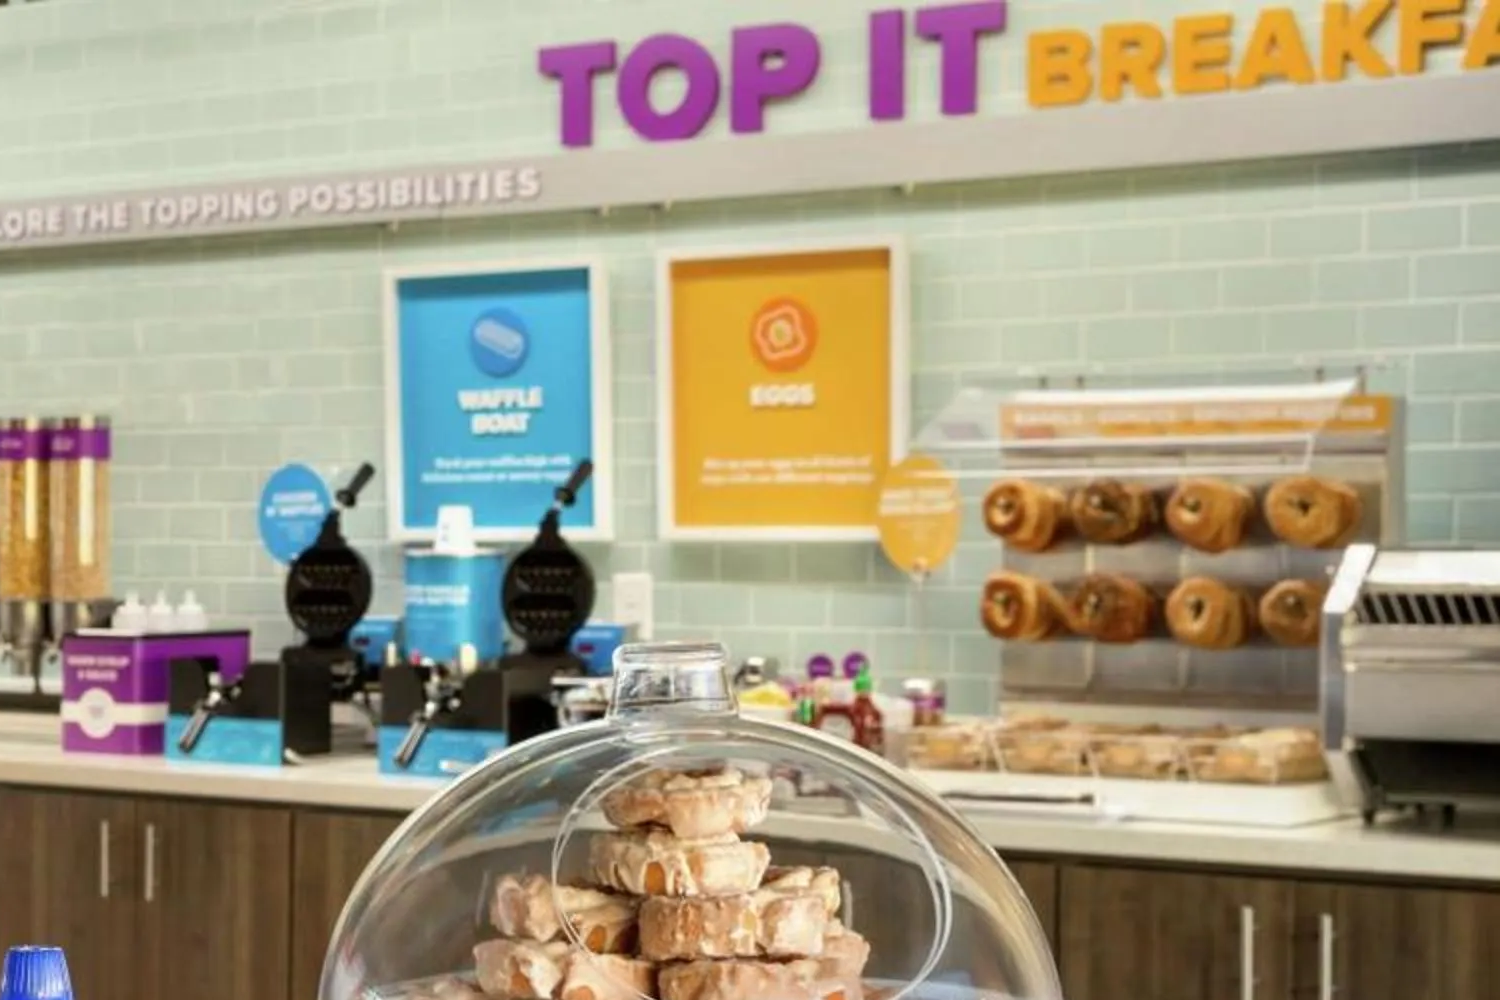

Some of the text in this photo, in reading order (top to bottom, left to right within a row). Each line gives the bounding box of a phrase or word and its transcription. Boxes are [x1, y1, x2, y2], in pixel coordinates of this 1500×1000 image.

[538, 22, 821, 148] TOP
[869, 1, 1007, 121] IT
[72, 201, 129, 230] THE
[140, 189, 278, 226] TOPPING
[288, 168, 541, 215] POSSIBILITIES
[458, 386, 543, 410] WAFFLE
